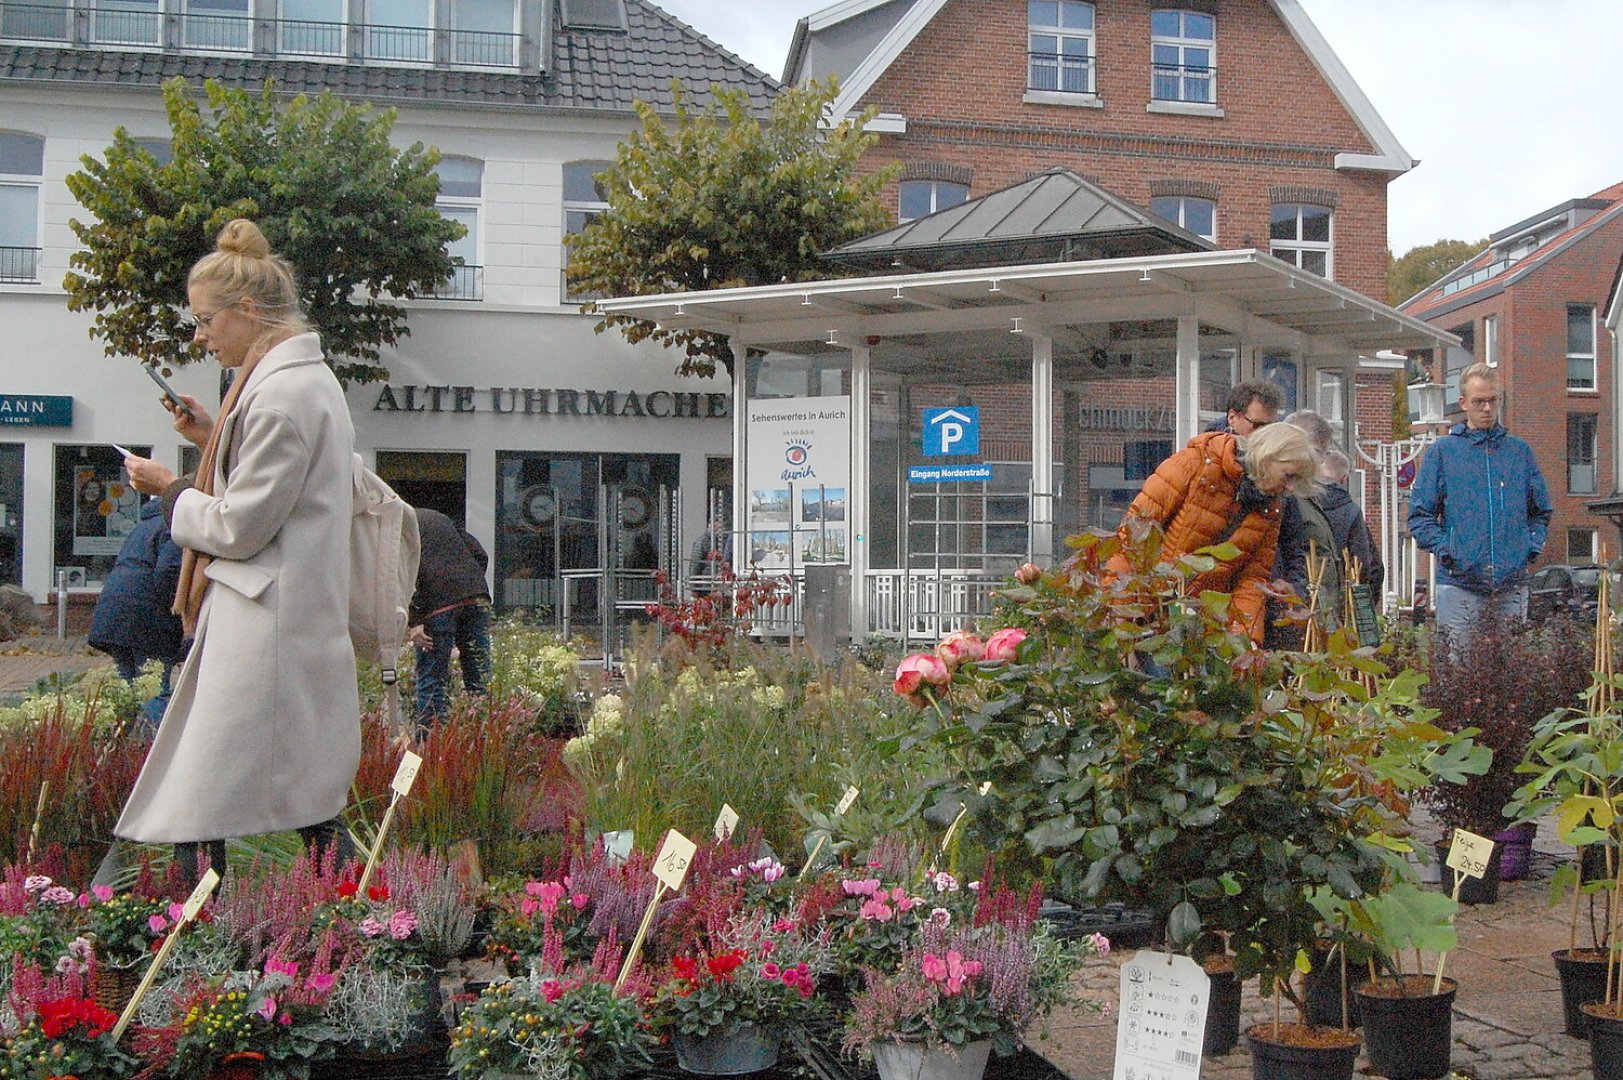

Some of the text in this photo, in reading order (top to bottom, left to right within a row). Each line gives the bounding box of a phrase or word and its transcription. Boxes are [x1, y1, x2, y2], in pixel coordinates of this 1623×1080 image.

[0, 400, 44, 413] ANN
[373, 384, 733, 419] ALTE UHRMACHE
[751, 410, 846, 423] Sehenswertes in Aurich
[941, 423, 963, 453] P
[780, 465, 816, 481] aurich
[910, 468, 990, 479] Eingang Norderstraße
